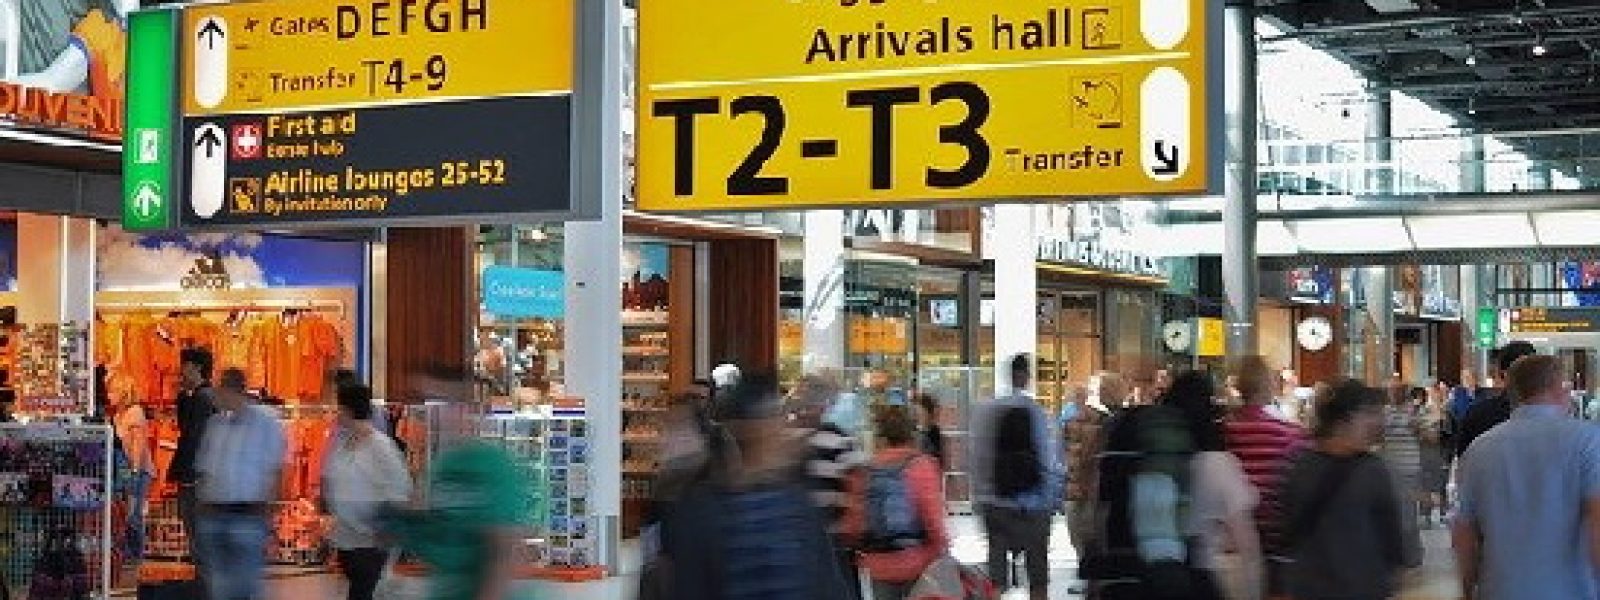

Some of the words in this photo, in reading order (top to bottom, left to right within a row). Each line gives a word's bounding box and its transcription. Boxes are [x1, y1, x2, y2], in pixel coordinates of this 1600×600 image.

[270, 17, 330, 36] Gates
[804, 16, 974, 64] Arrivals
[991, 7, 1071, 51] hall
[270, 66, 356, 93] Transfer
[361, 54, 446, 96] T4-9
[267, 114, 315, 138] First
[319, 110, 356, 135] aid
[652, 81, 992, 197] T2-T3
[1004, 145, 1124, 173] Transfer
[264, 169, 338, 195] Airline
[345, 165, 435, 196] lounges
[441, 159, 505, 187] 25-52
[264, 197, 282, 216] By
[284, 194, 353, 212] invitation
[354, 194, 388, 213] only
